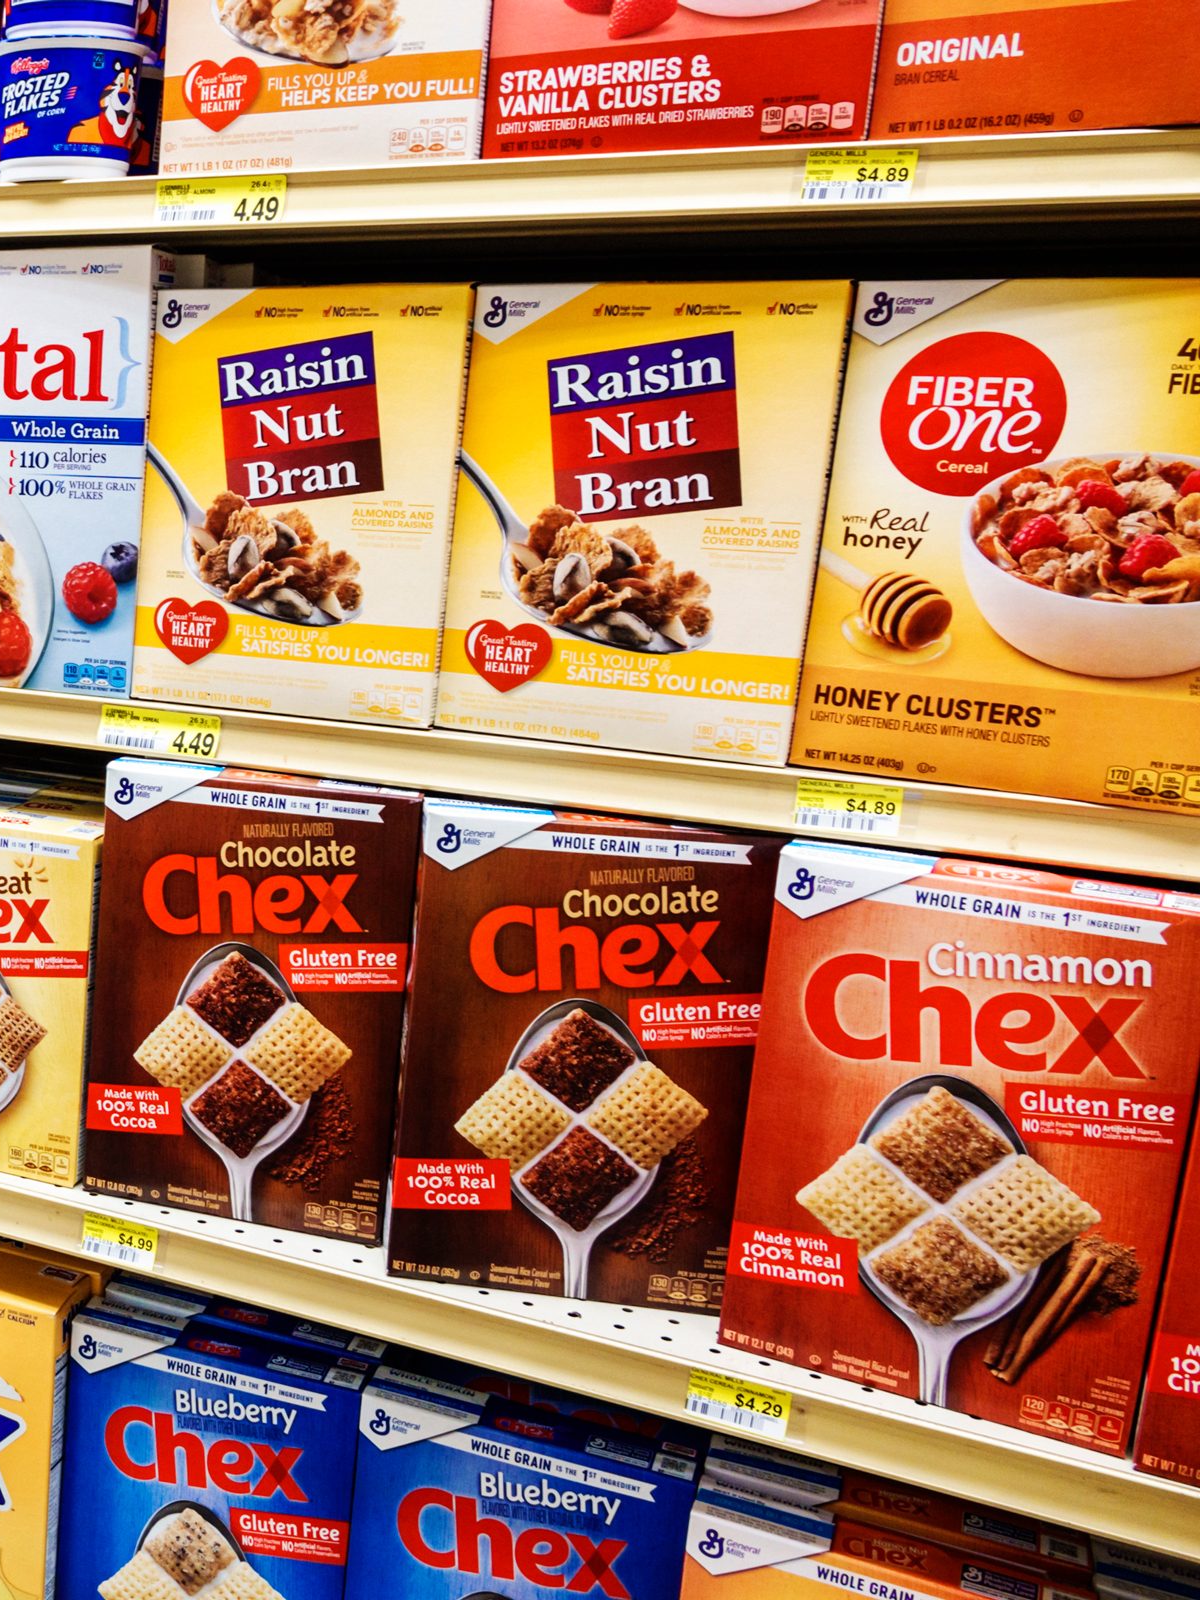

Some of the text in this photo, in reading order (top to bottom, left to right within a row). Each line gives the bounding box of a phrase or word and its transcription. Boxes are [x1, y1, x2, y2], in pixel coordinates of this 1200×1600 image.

[897, 33, 1024, 66] ORIGINAL
[2, 72, 69, 103] FROSTED
[196, 72, 247, 88] Great Tasting
[268, 70, 368, 91] FILLS YOU UP &
[500, 54, 711, 94] STRAWBERRIES &
[894, 69, 959, 85] BRAN CEREAL
[4, 89, 61, 119] FLAKES
[201, 83, 242, 100] HEART
[281, 78, 475, 107] HELPS KEEP YOU FULL!
[497, 105, 754, 135] LIGHTLY SWEETENED FLAKES WITH REAL DRIED STRAWBERRIES
[499, 94, 589, 118] VANILLA
[856, 167, 909, 183] $4.89
[234, 196, 280, 222] 4.49
[895, 305, 915, 314] Mills
[896, 296, 934, 305] General
[221, 347, 367, 402] Raisin
[552, 348, 726, 408] Raisin
[907, 376, 1034, 408] FIBER
[12, 423, 120, 440] Whole Grain
[251, 404, 344, 448] Nut
[586, 411, 696, 458] Nut
[19, 448, 107, 469] 110 calories
[936, 460, 988, 474] Cereal
[18, 479, 136, 497] 100% WHOLE GRAIN
[243, 459, 360, 501] Bran
[574, 471, 714, 516] Bran
[68, 490, 104, 500] FLAKES
[842, 508, 930, 532] WITH Real
[843, 528, 923, 559] honey
[242, 639, 429, 668] SATISFIES YOU LONGER!
[814, 684, 900, 712] HONEY
[810, 710, 844, 726] LIGHTLY
[846, 715, 900, 731] SWEETENED
[903, 720, 937, 736] FLAKES
[940, 724, 964, 738] WITH
[966, 727, 997, 742] HONEY
[173, 730, 214, 756] 4.49
[211, 791, 248, 806] WHOLE
[252, 794, 286, 809] GRAIN
[332, 806, 370, 815] INGREDIENT
[846, 799, 896, 815] $4.89
[243, 823, 334, 837] NATURALLY FLAVORED
[220, 840, 356, 868] Chocolate
[143, 854, 365, 935] Chex
[563, 887, 719, 918] Chocolate
[916, 890, 968, 912] WHOLE
[972, 900, 1021, 920] GRAIN
[1040, 912, 1055, 921] THE
[1087, 919, 1141, 934] INGREDIENT
[289, 950, 397, 968] Gluten Free
[470, 905, 726, 993] Chex
[928, 940, 1152, 987] Cinnamon
[805, 953, 1148, 1081] Chex
[96, 1101, 169, 1114] 100% Real
[104, 1089, 159, 1100] Made With
[1020, 1091, 1175, 1122] Gluten Free
[110, 1114, 157, 1129] Cocoa
[118, 1234, 153, 1251] $4.99
[754, 1230, 828, 1251] Made With
[742, 1243, 841, 1269] 100% Real
[740, 1257, 844, 1287] Cinnamon
[174, 1388, 297, 1434] Blueberry
[735, 1393, 783, 1417] $4.29
[104, 1405, 309, 1504] Chex
[479, 1472, 621, 1524] Blueberry
[239, 1514, 339, 1543] Gluten Free
[397, 1487, 632, 1600] Chex
